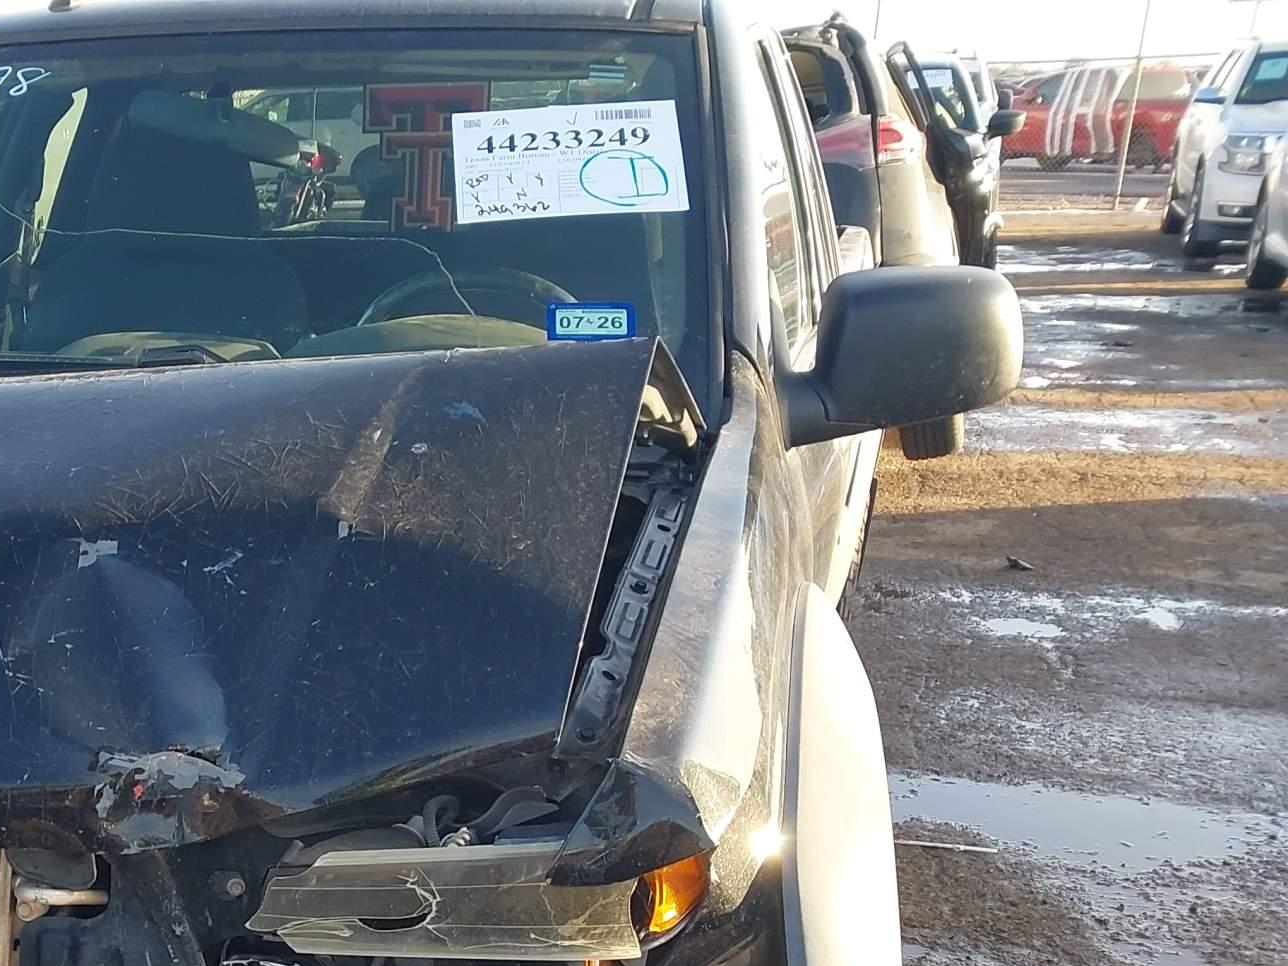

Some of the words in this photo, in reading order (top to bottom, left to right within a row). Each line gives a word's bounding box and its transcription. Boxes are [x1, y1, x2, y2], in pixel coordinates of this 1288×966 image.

[476, 126, 651, 154] 44233249
[559, 316, 584, 329] 07
[597, 316, 623, 329] 26
